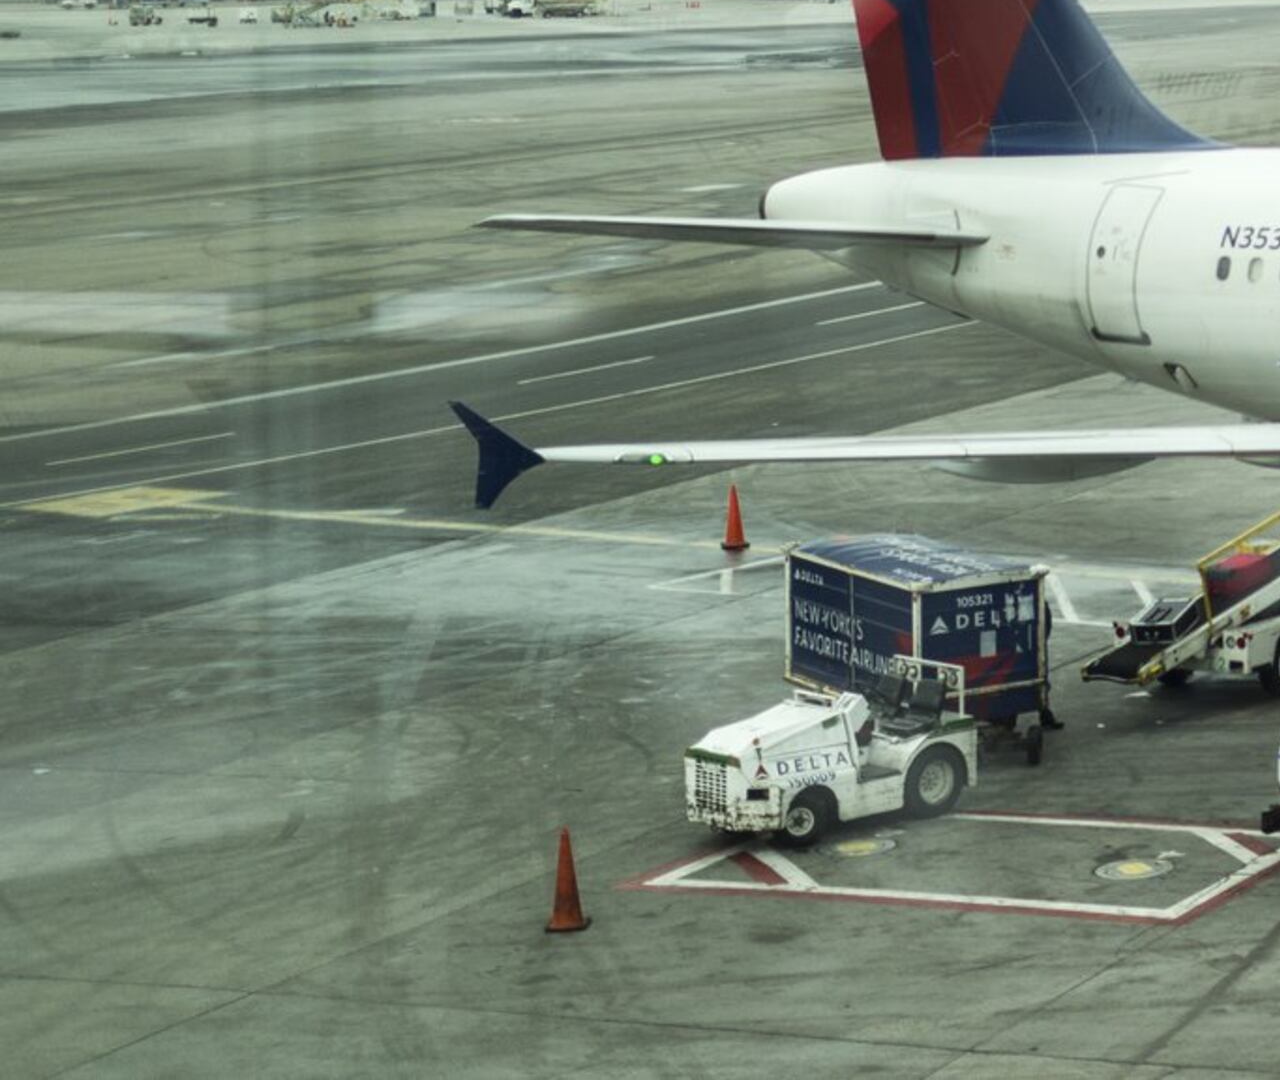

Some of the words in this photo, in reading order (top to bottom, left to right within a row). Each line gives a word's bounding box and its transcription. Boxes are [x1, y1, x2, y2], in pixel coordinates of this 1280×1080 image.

[794, 598, 820, 625] NEW
[956, 594, 993, 608] 105321
[794, 626, 850, 663] FAVORITE
[776, 750, 849, 776] DELTA
